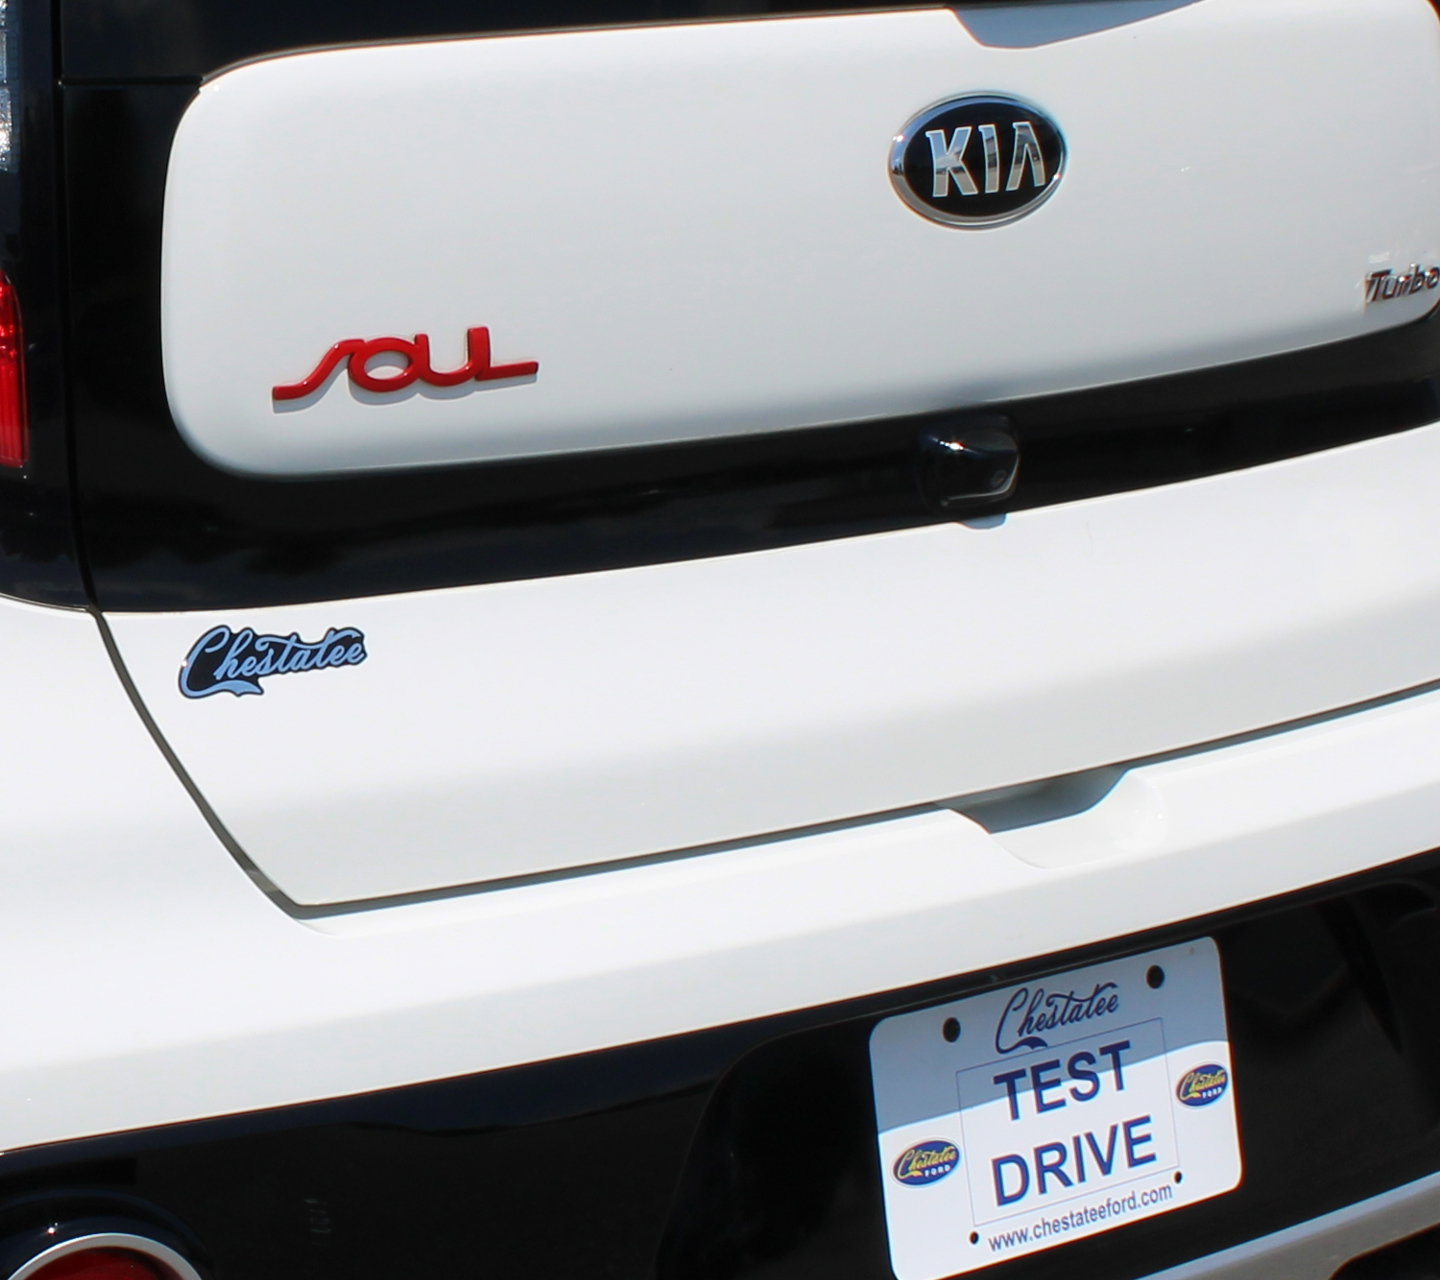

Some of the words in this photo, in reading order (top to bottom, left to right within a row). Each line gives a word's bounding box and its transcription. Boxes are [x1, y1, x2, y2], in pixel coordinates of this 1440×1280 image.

[925, 121, 1046, 198] KIA
[1364, 264, 1440, 304] Turbo
[178, 624, 368, 699] Chestatee
[996, 982, 1119, 1054] Chestatee
[993, 1040, 1132, 1121] TEST
[991, 1115, 1157, 1207] DRIVE
[988, 1182, 1173, 1252] www.chestateeford.com
